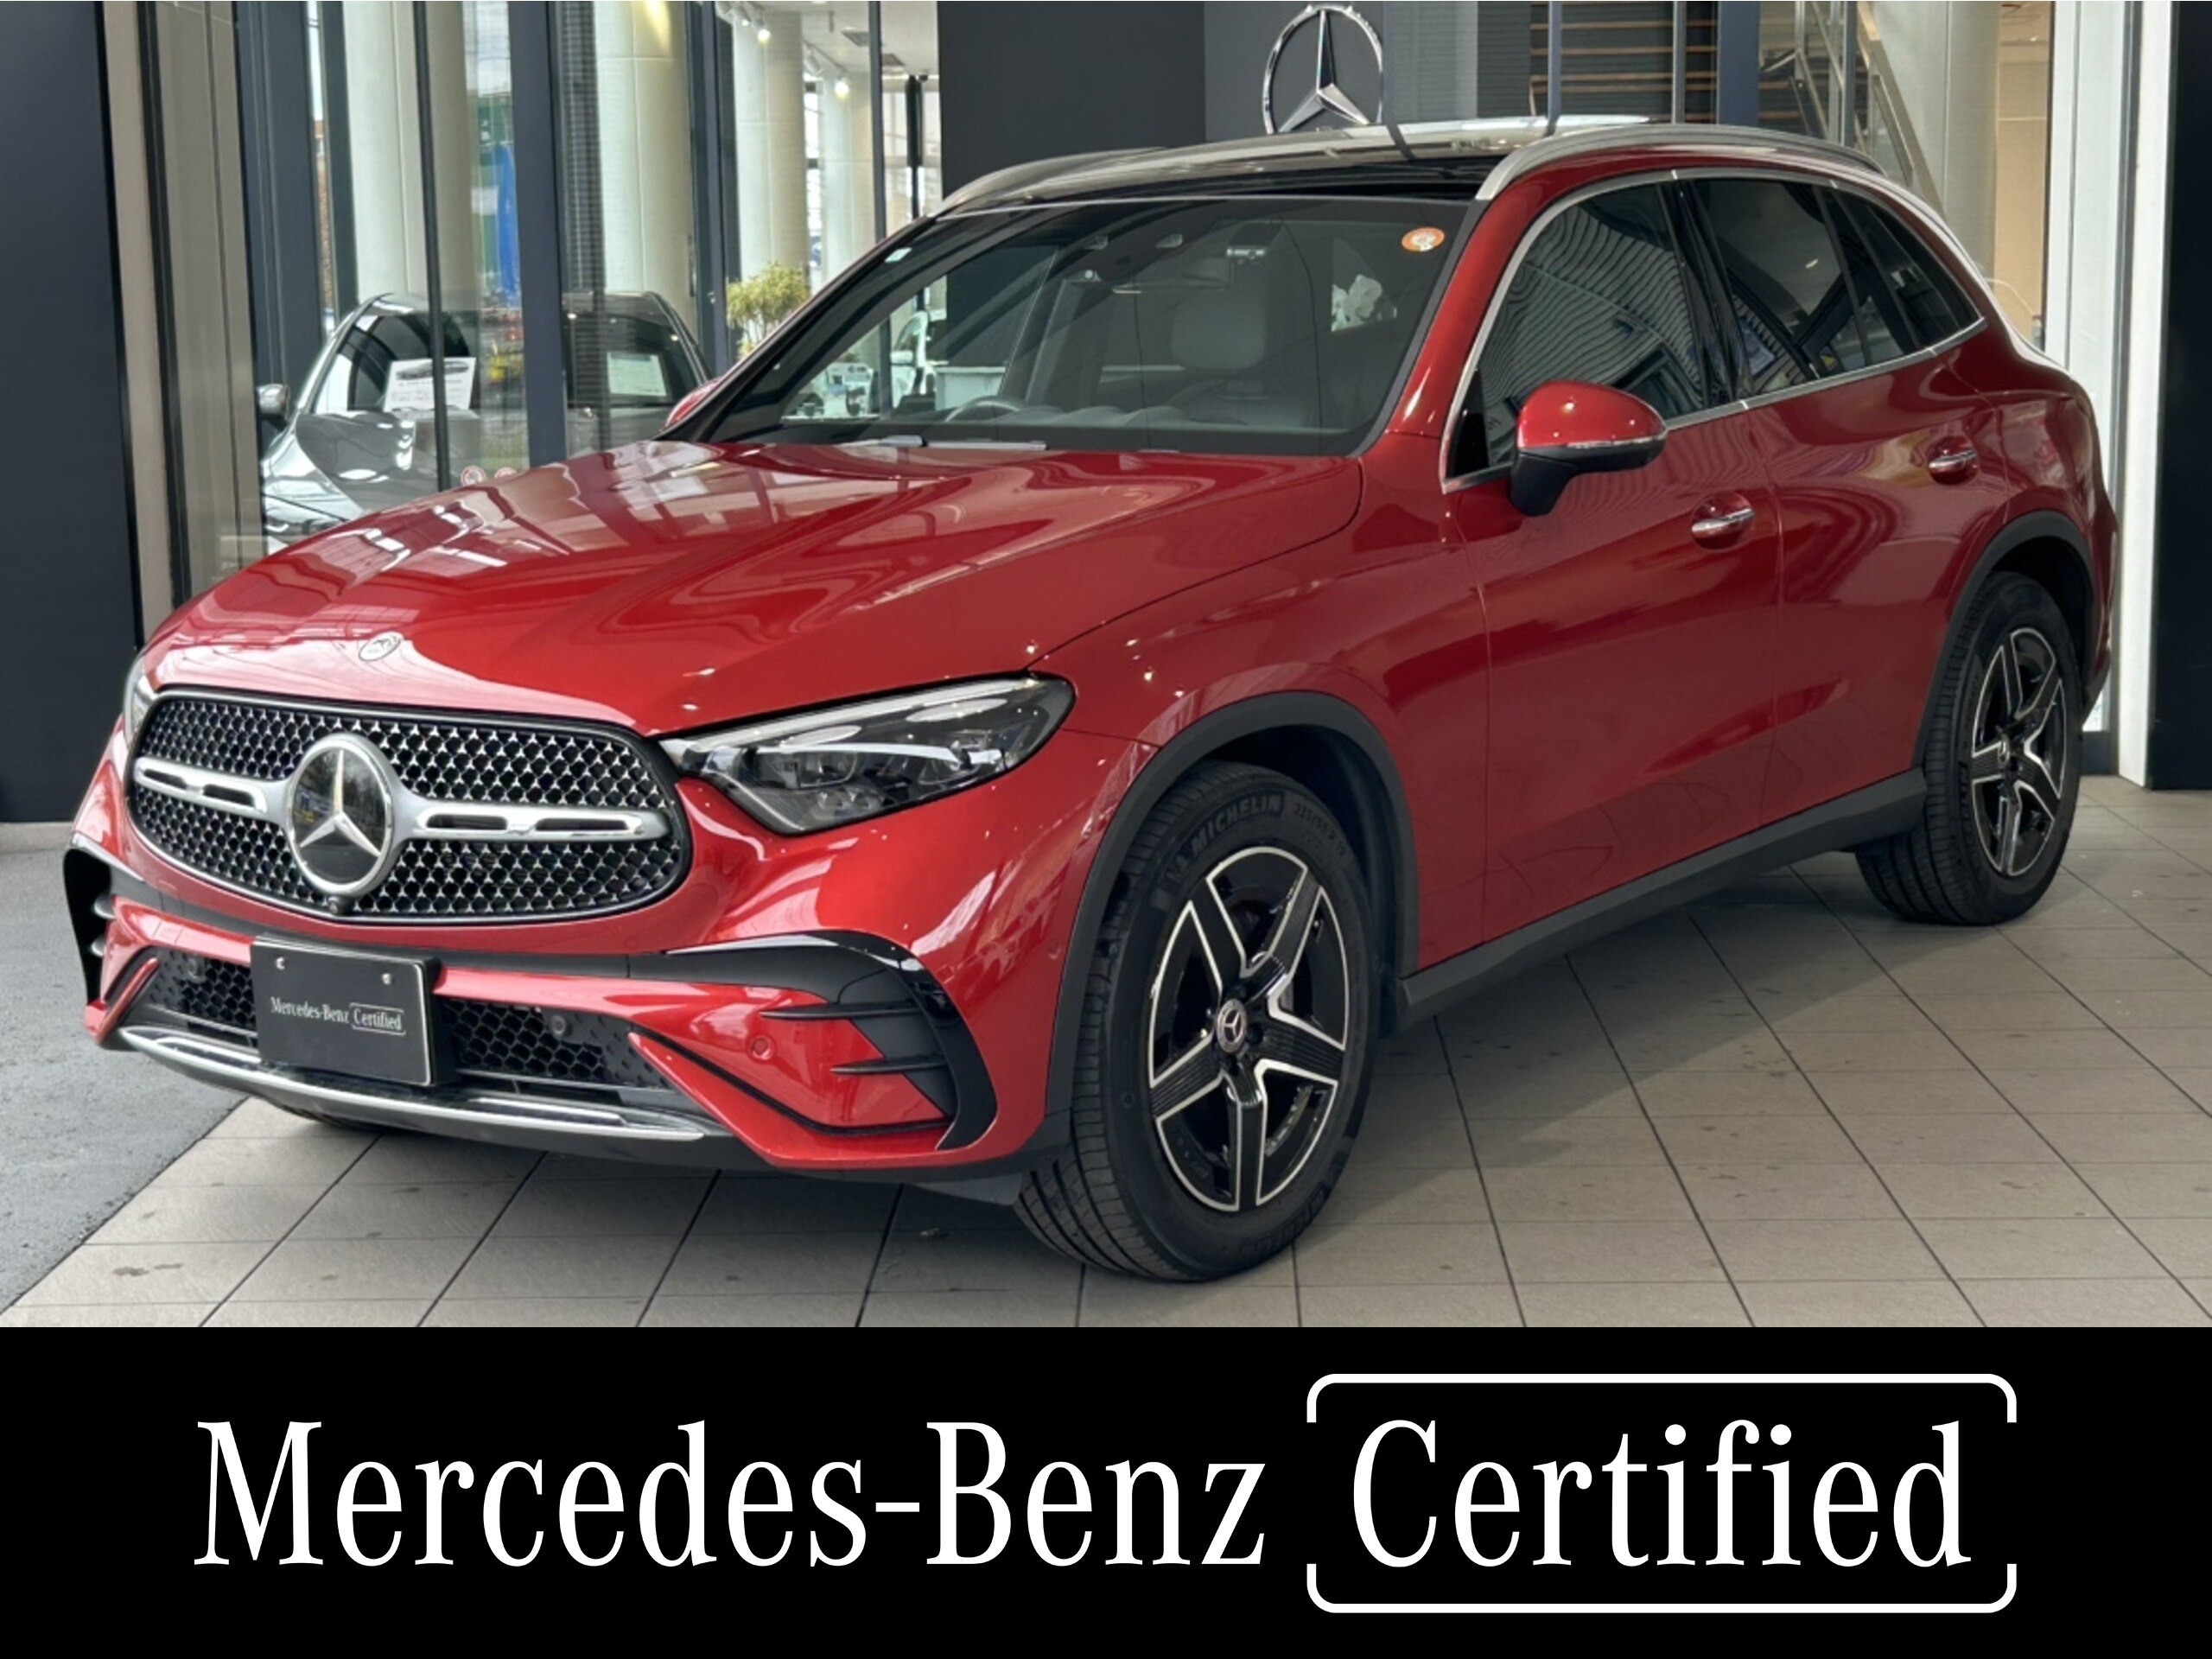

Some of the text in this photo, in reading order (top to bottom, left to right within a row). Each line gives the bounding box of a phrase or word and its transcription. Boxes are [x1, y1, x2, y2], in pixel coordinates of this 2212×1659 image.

[1192, 794, 1282, 857] MICHELIN
[270, 995, 403, 1031] Mercedes-Benz Certified
